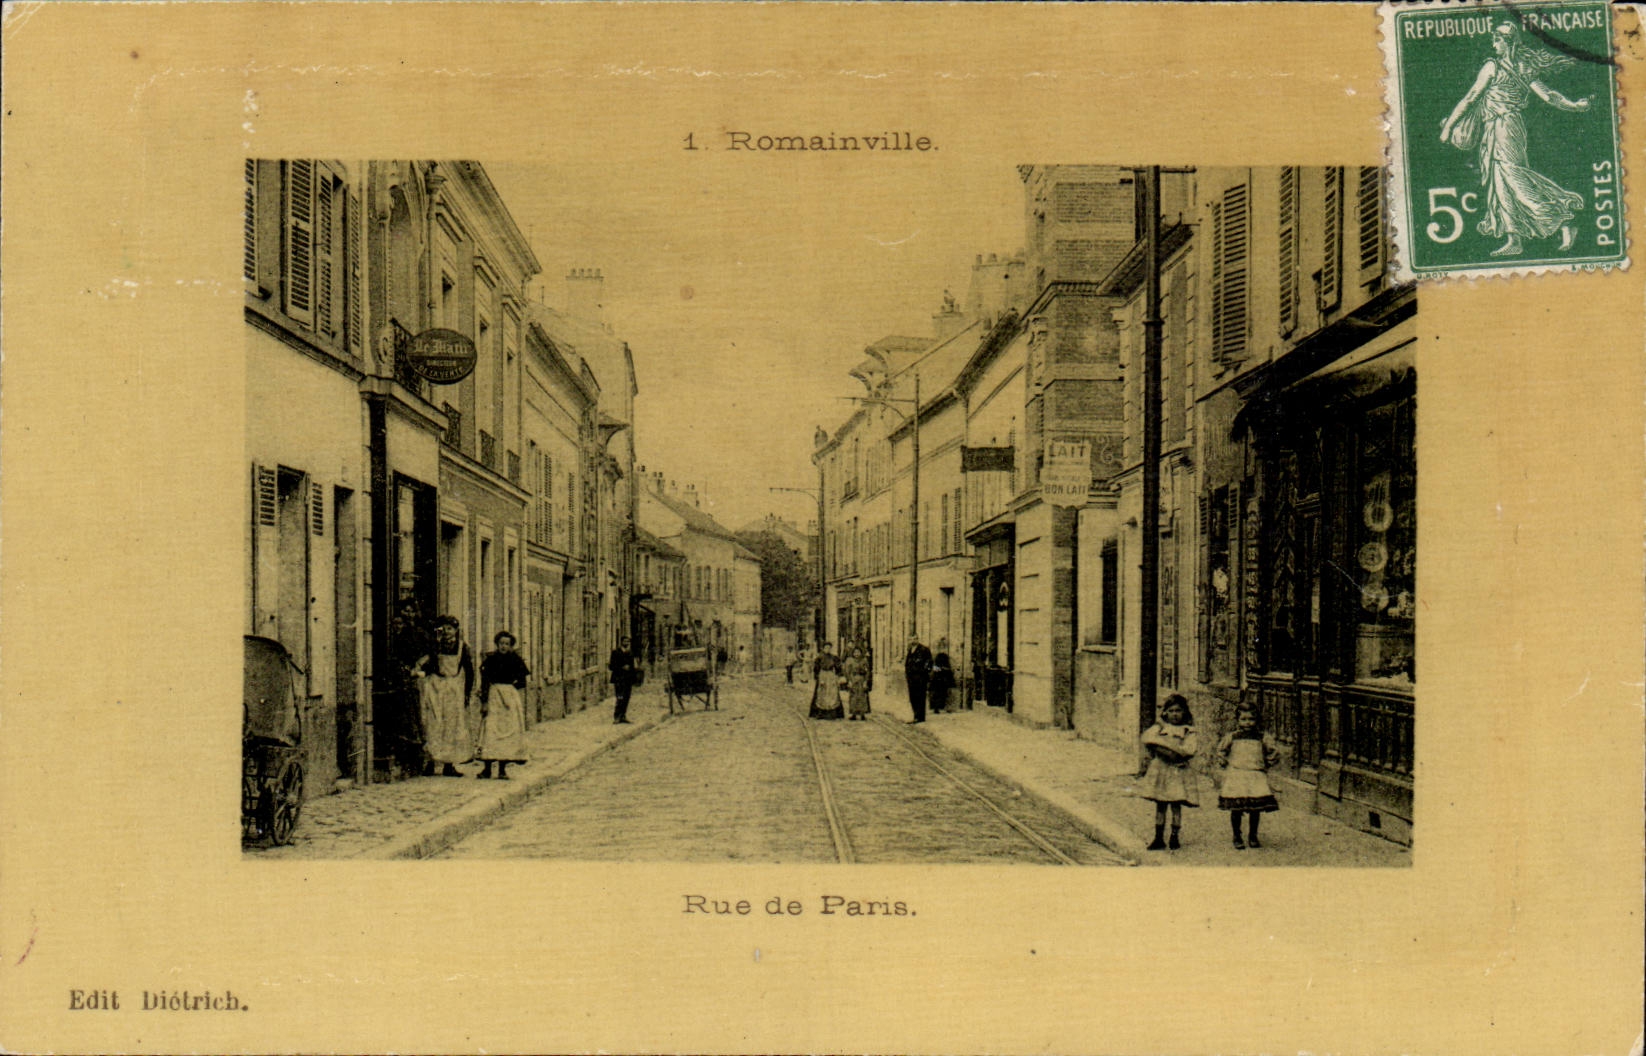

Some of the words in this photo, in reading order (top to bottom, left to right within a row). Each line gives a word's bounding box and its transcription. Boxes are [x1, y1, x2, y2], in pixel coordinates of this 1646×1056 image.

[1521, 10, 1604, 32] FRANÇAISE
[683, 132, 709, 151] 1.
[726, 131, 939, 151] Romainville.
[1593, 160, 1615, 246] POSTES
[1048, 443, 1087, 458] LAIT
[1044, 483, 1064, 495] BON
[682, 894, 751, 915] Rue
[765, 897, 803, 915] de
[820, 895, 917, 916] Paris.
[69, 989, 121, 1011] Edit
